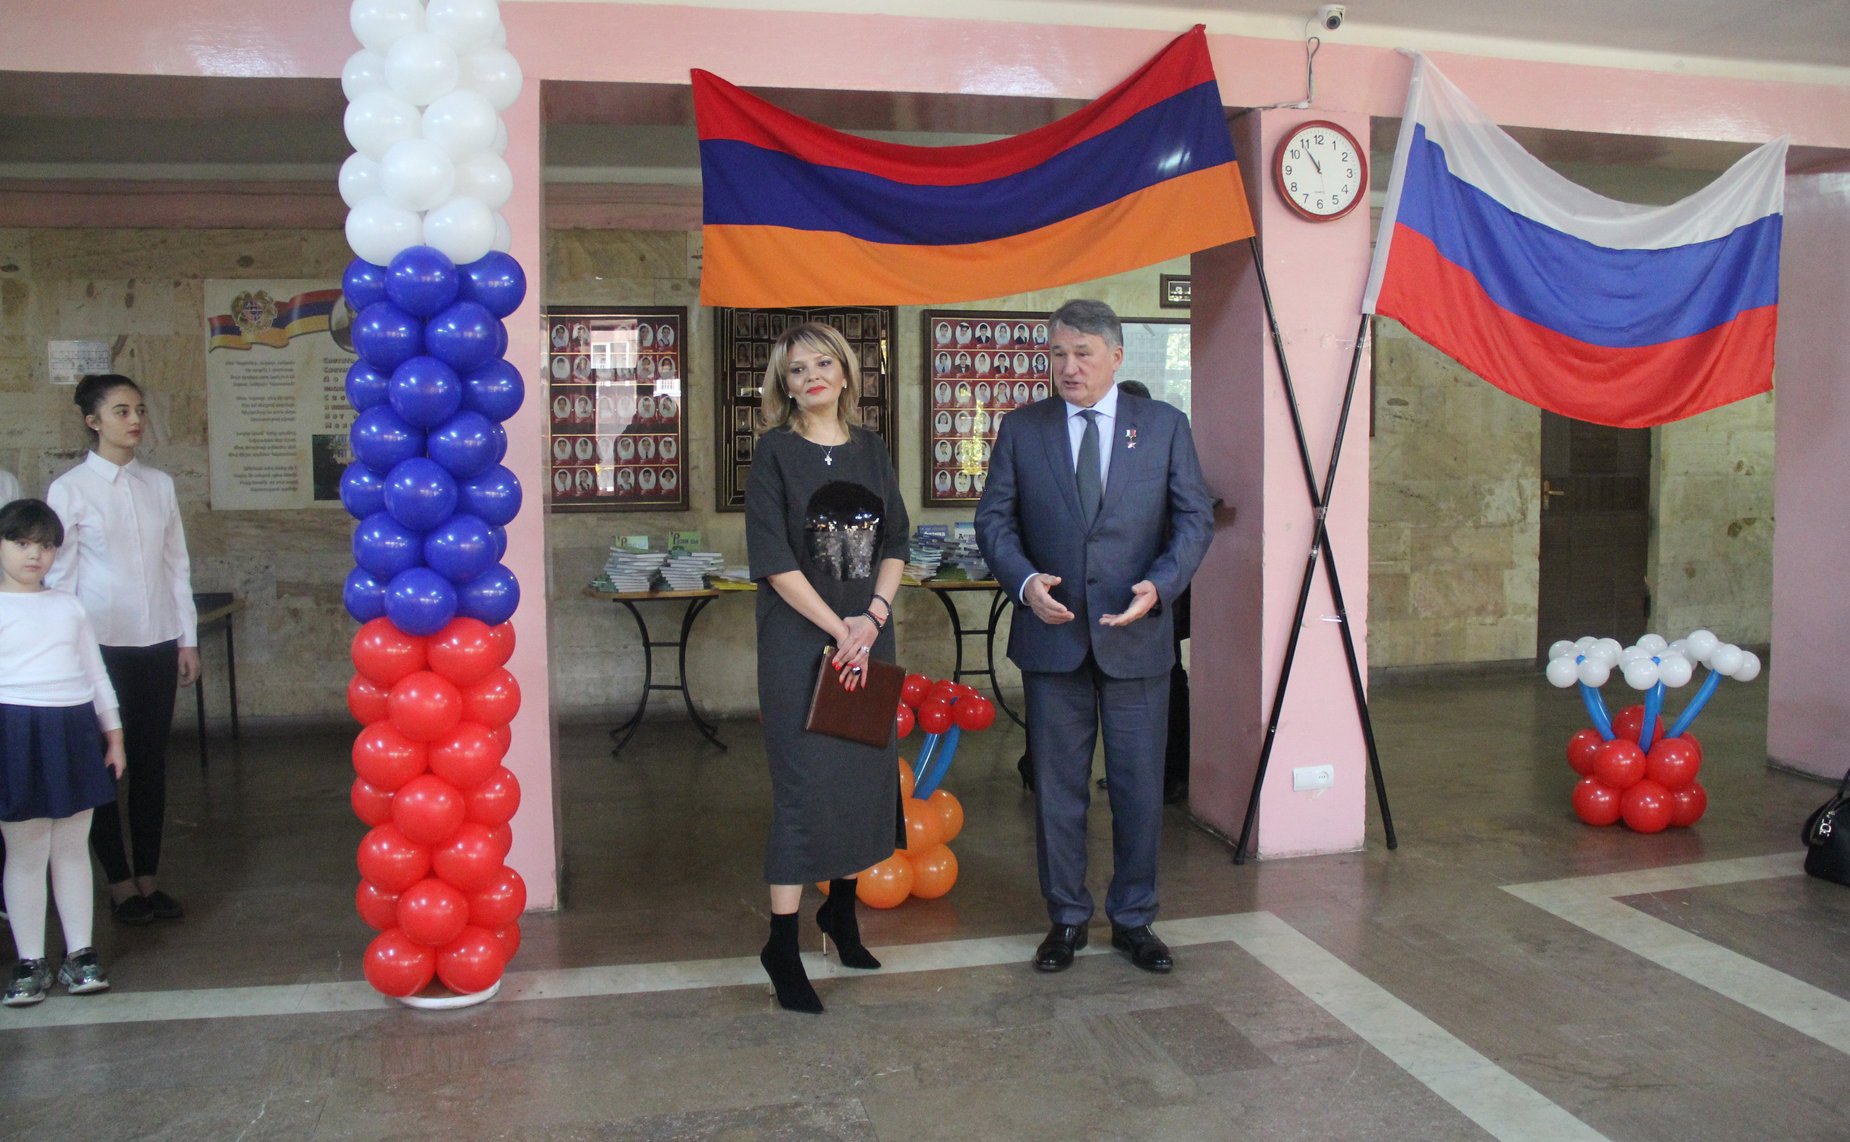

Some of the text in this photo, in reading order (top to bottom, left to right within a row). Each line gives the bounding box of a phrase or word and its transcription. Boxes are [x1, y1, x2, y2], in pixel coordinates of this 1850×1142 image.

[1301, 139, 1309, 149] 11
[1314, 135, 1324, 145] 12
[1332, 141, 1336, 150] 1
[1290, 149, 1300, 159] 10
[1342, 152, 1348, 162] 2
[1285, 166, 1292, 175] 9
[1347, 169, 1353, 178] 3
[1291, 182, 1297, 192] 8
[1341, 185, 1348, 194] 4
[1303, 193, 1309, 203] 7
[1332, 195, 1339, 204] 5
[1317, 199, 1323, 209] 6
